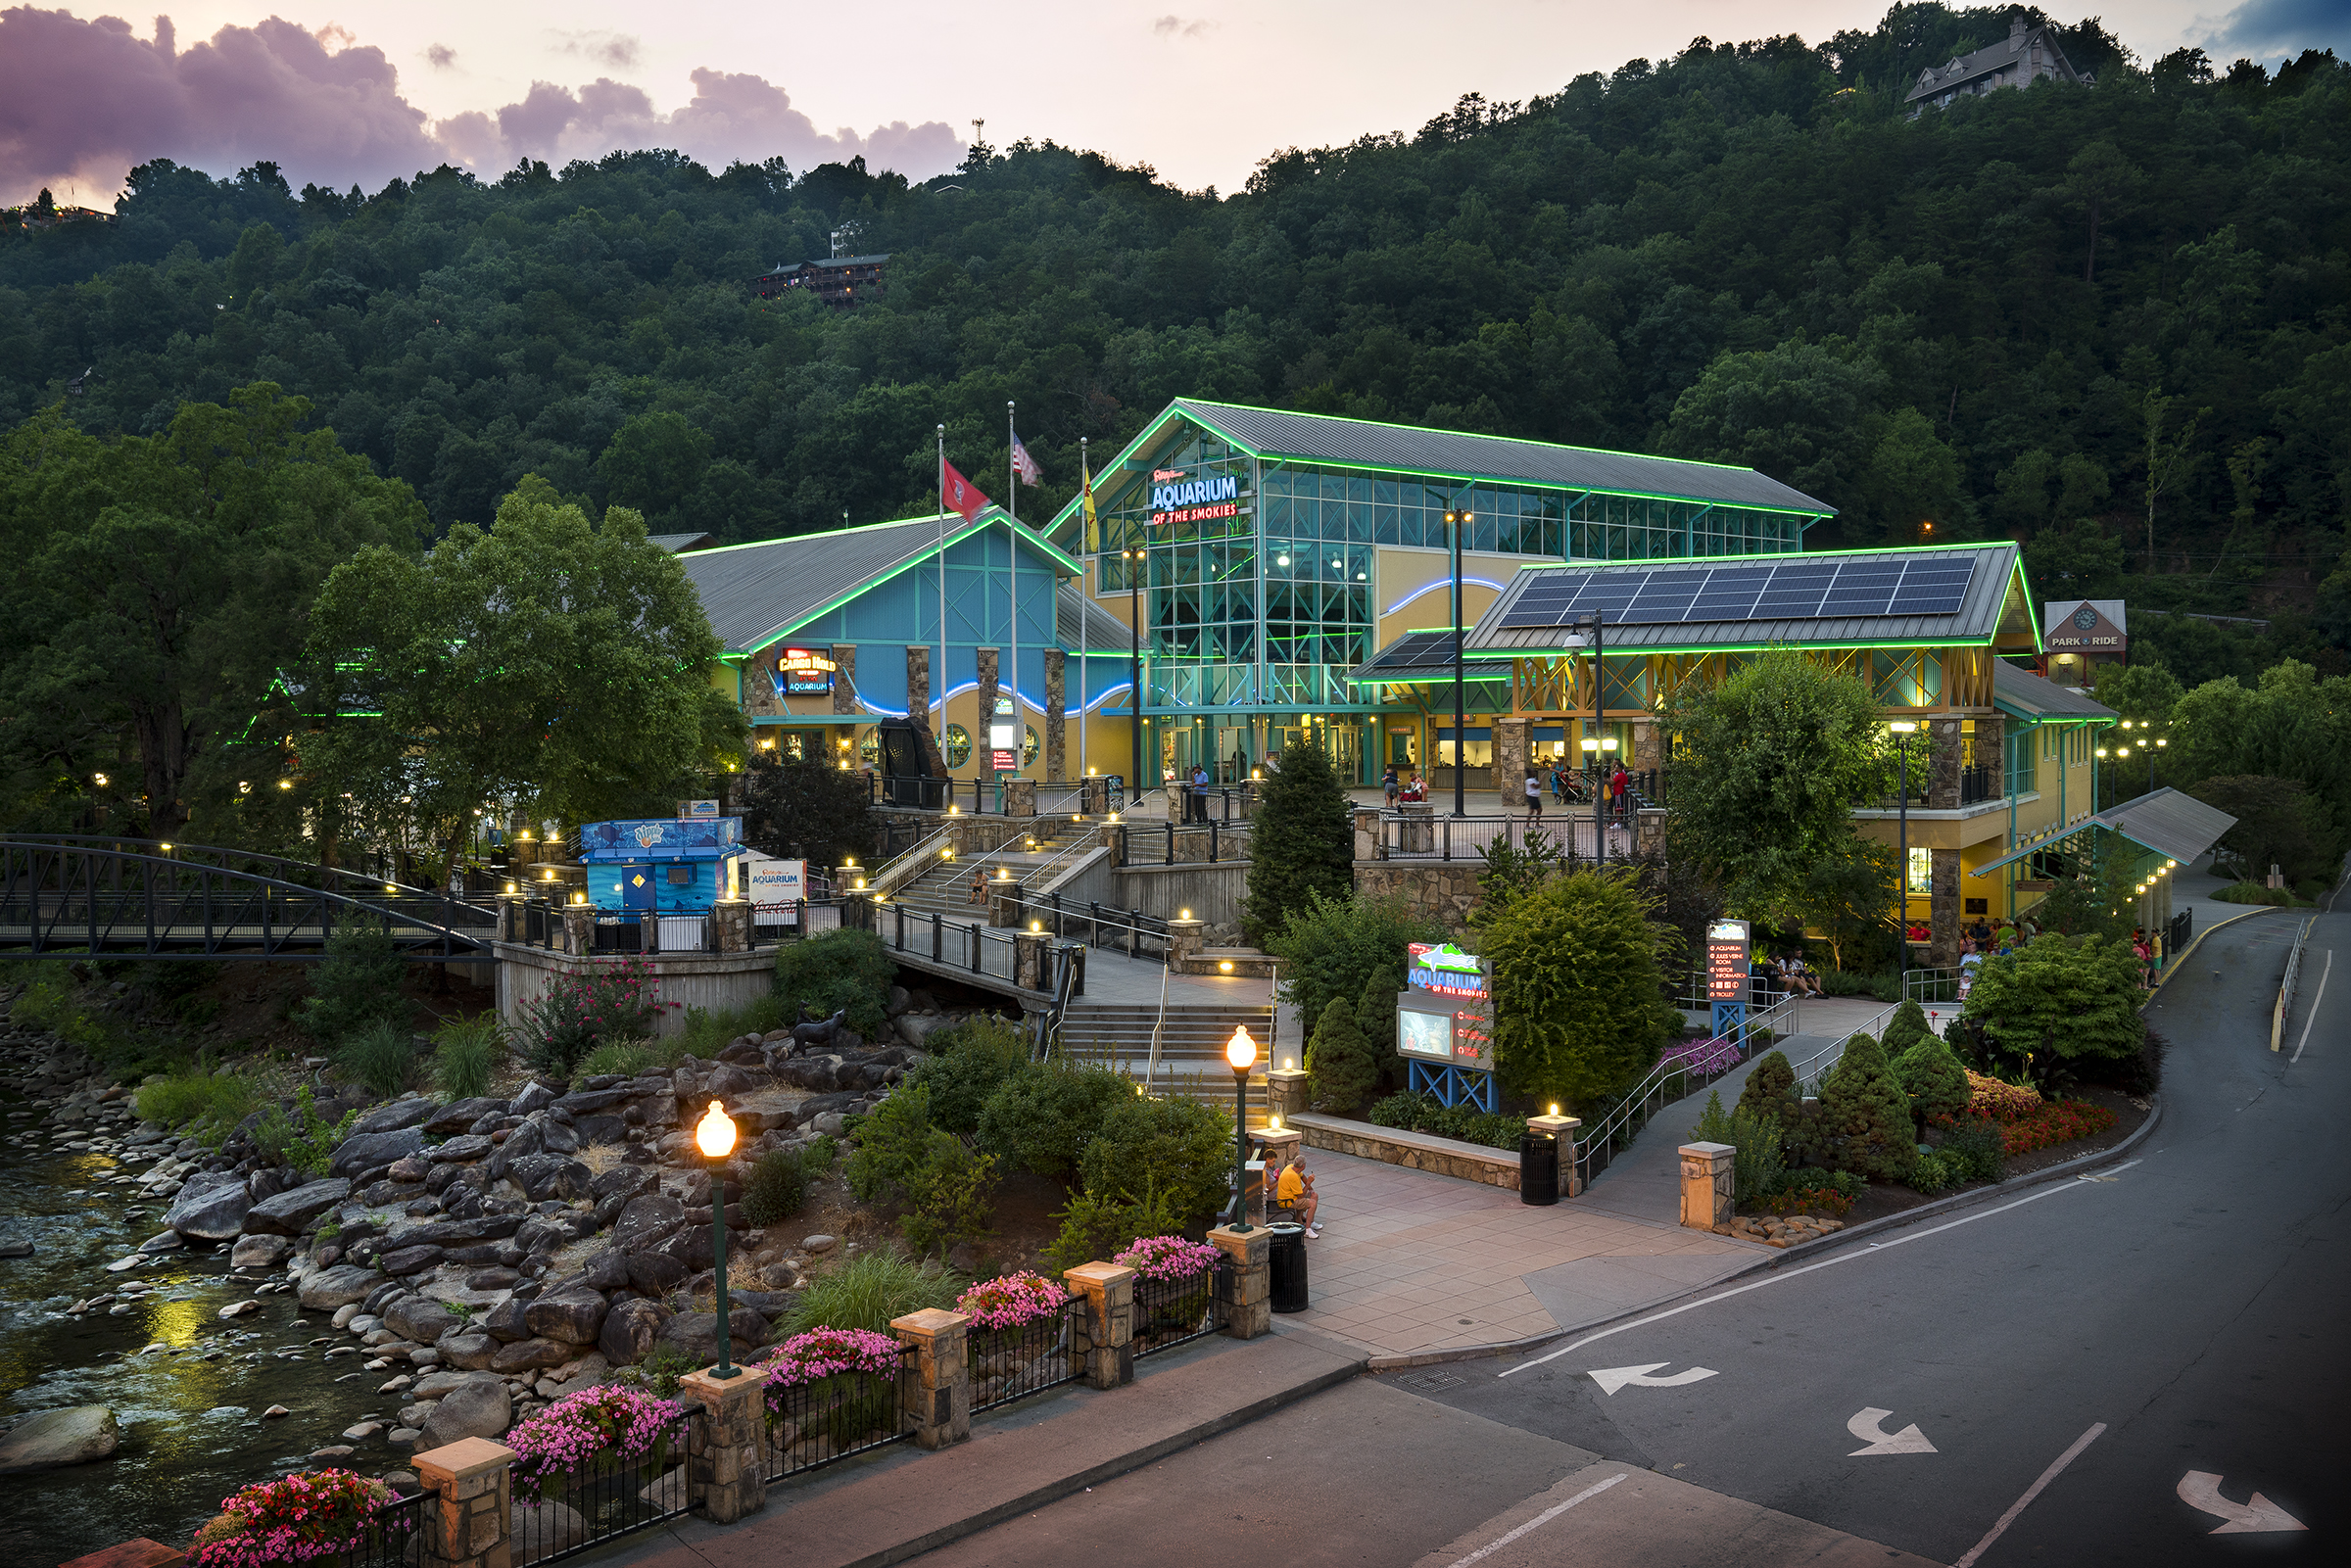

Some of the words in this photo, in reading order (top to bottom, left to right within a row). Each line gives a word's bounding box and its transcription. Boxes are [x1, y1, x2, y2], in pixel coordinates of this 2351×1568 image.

[1152, 476, 1237, 512] AQUARIUM
[1153, 513, 1165, 525] OF
[1169, 510, 1188, 523] THE
[1192, 503, 1237, 521] SMOKIES
[2052, 638, 2081, 646] PARK
[2092, 637, 2118, 645] RIDE
[779, 658, 811, 672] CARGO
[812, 656, 836, 672] HOLD
[789, 683, 827, 692] AQUARIUM
[752, 875, 798, 884] AQUARIUM
[1407, 968, 1482, 991] AQUARIUM
